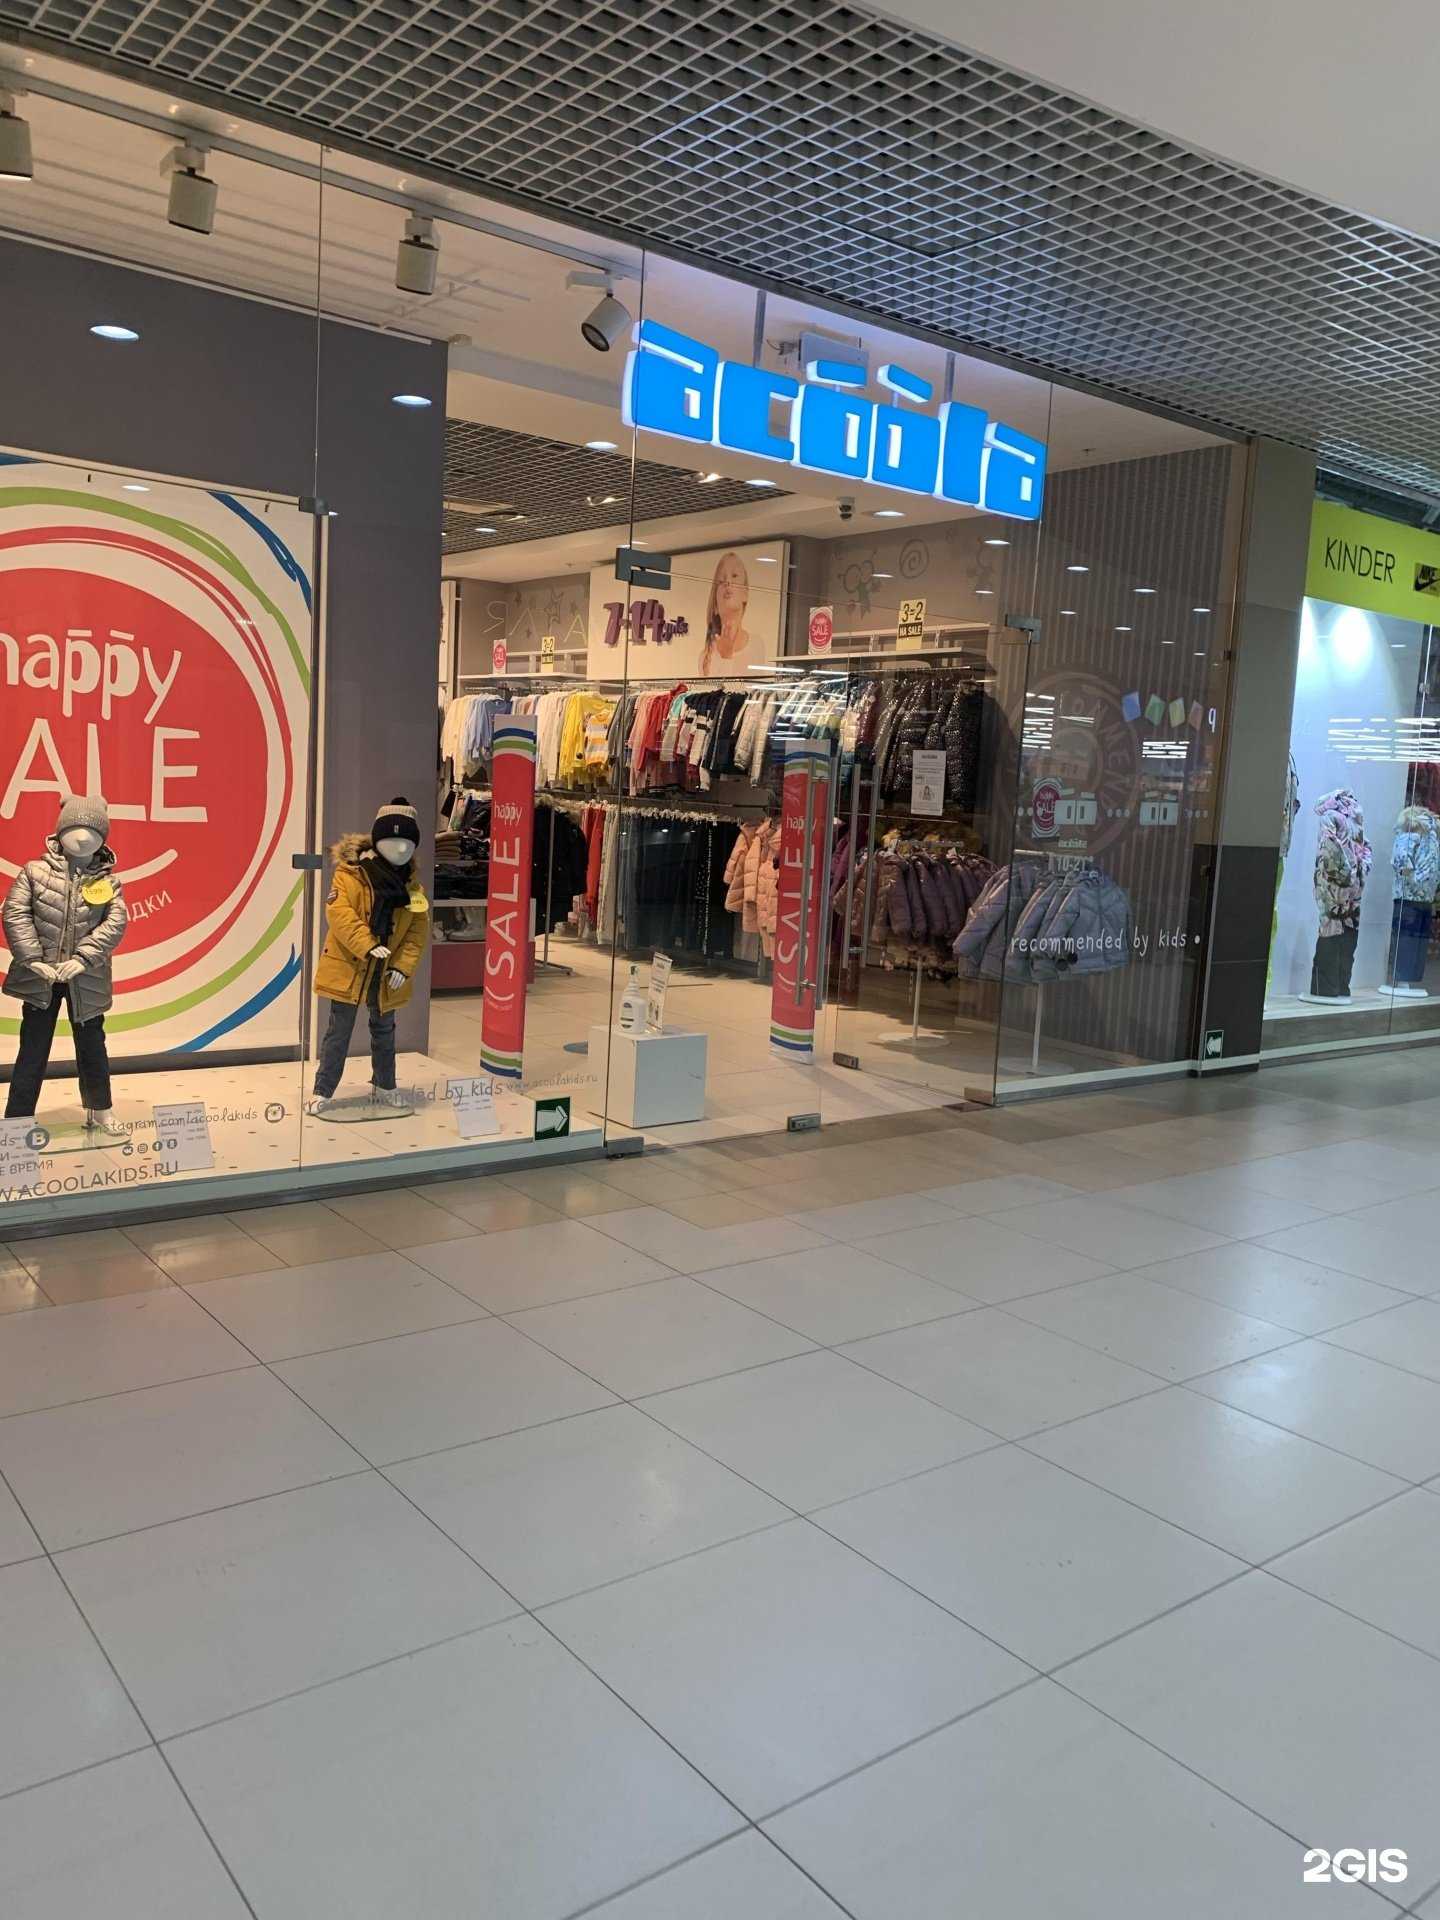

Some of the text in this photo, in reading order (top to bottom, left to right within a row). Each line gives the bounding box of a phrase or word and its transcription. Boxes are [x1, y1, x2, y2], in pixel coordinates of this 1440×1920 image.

[621, 319, 1048, 521] acoola
[1324, 537, 1396, 584] KINDER
[902, 601, 924, 623] 3=2
[811, 624, 829, 636] SALE
[0, 717, 208, 823] ALE
[494, 802, 522, 825] happy
[485, 837, 520, 980] SALE
[1010, 925, 1187, 957] recommended by kids
[445, 1079, 464, 1106] by
[471, 1077, 503, 1098] kids
[9, 1159, 53, 1175] ВРЕМЯ
